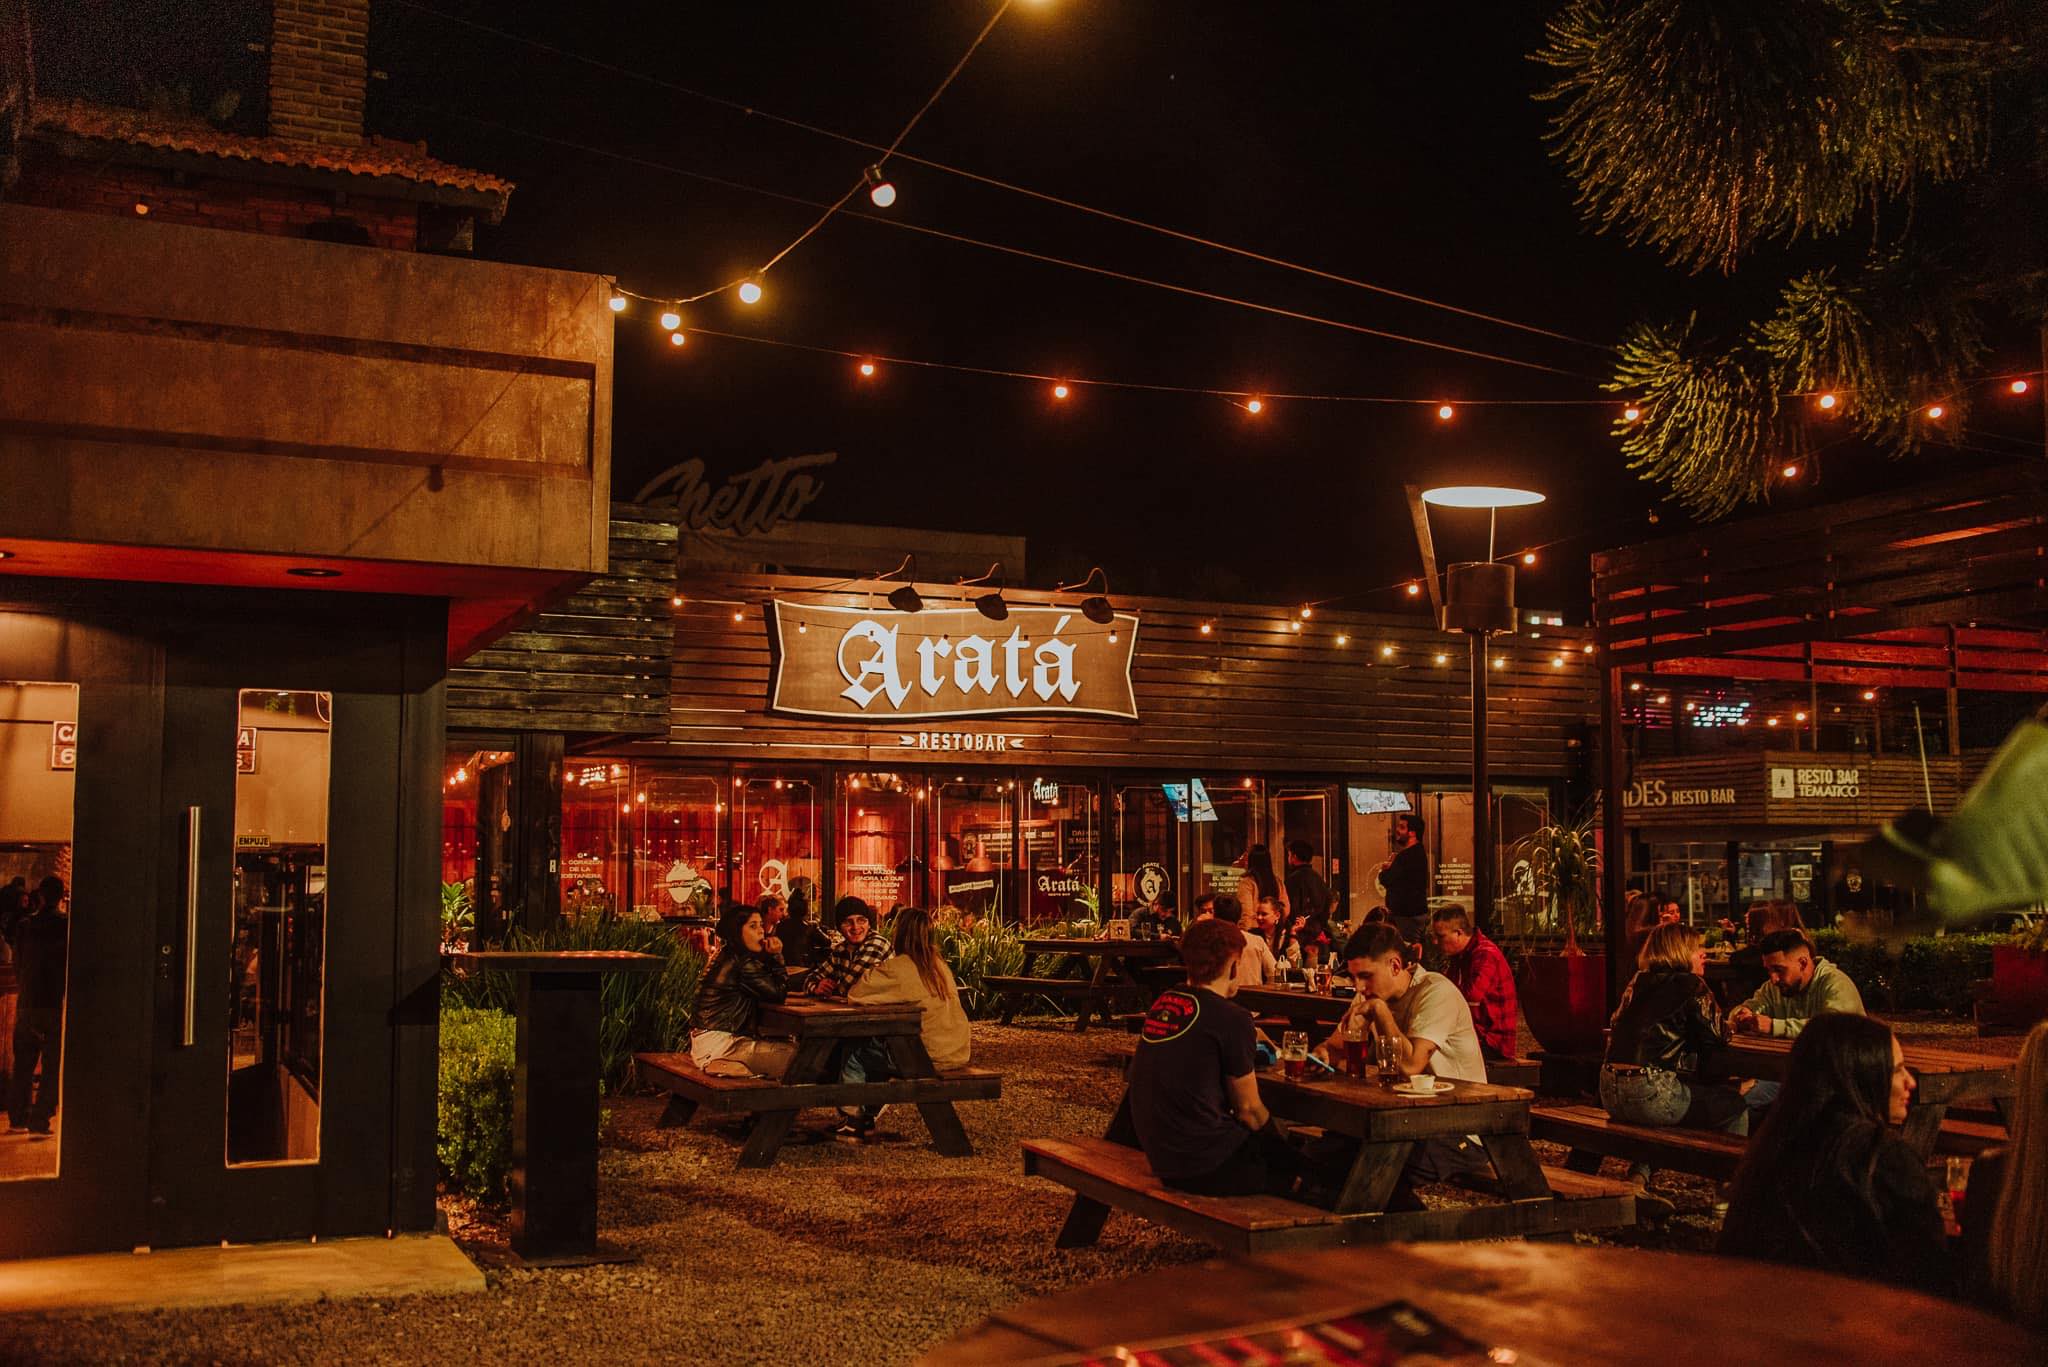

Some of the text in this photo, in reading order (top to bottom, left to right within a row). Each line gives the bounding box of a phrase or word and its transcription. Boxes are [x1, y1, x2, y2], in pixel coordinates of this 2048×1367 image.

[633, 452, 838, 536] Ghetto
[837, 614, 1082, 710] Aratá
[919, 732, 1006, 751] RESTOBAR
[1797, 768, 1859, 784] RESTO BAR
[1672, 790, 1709, 805] RESTO
[1711, 788, 1735, 804] BAR
[1797, 785, 1860, 797] TEMATICO
[238, 837, 269, 846] EMPUJE
[1038, 875, 1079, 891] Aratá
